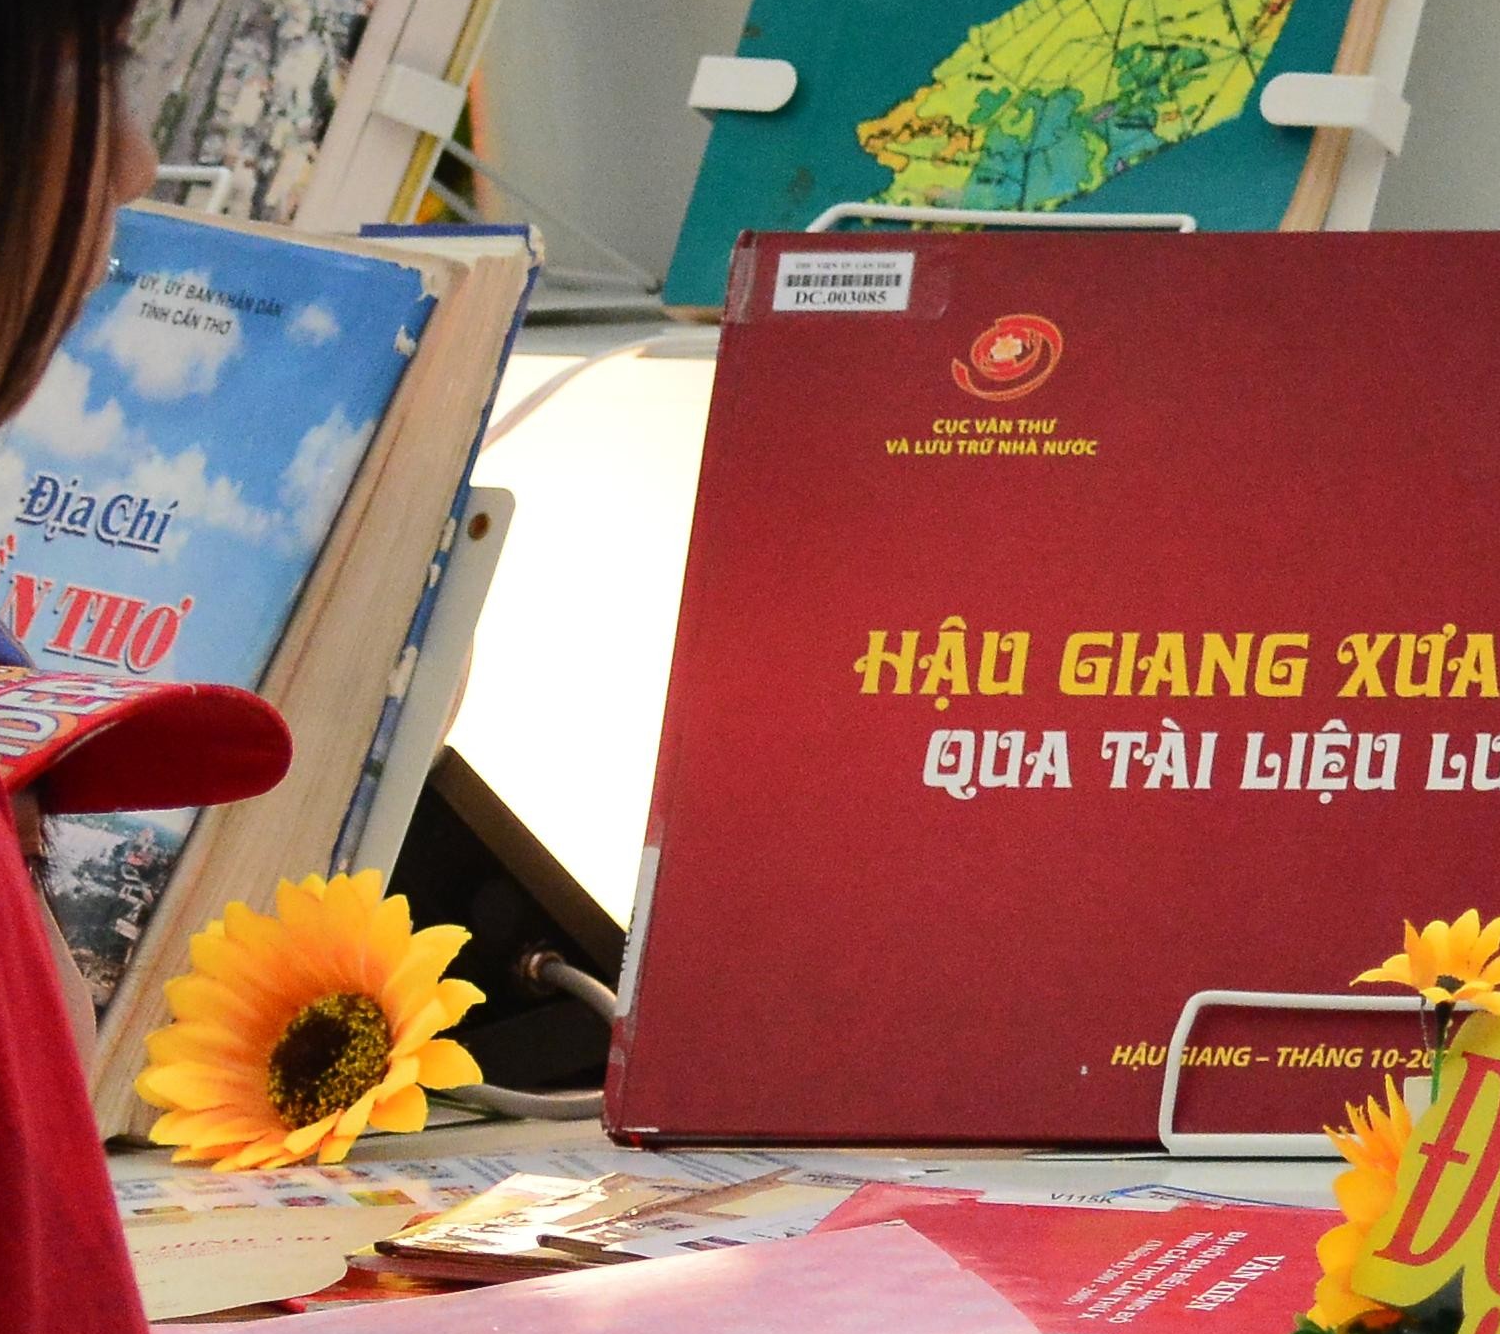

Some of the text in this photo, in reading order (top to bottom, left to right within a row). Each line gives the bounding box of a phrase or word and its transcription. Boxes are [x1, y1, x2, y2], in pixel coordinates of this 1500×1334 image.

[794, 290, 888, 307] DC.003085
[202, 317, 233, 335] THƠ
[885, 436, 1098, 455] VÀ LƯU TRỮ NHÀ NƯỚC
[932, 417, 1058, 436] CỤC VĂN THƯ
[16, 474, 180, 553] Địa Chí
[43, 585, 194, 674] THƠ
[853, 615, 1032, 711] HẬU
[1059, 631, 1312, 699] GIANG
[1335, 621, 1500, 699] XƯA
[920, 727, 1074, 802] QUA
[1099, 717, 1219, 791] TÀI
[1240, 719, 1402, 804] LIỆU
[1111, 1041, 1167, 1071] HẬU
[1176, 1046, 1252, 1067] GIANG
[1276, 1042, 1364, 1067] THÁNG
[1185, 1255, 1285, 1311] VĂN KIỆN
